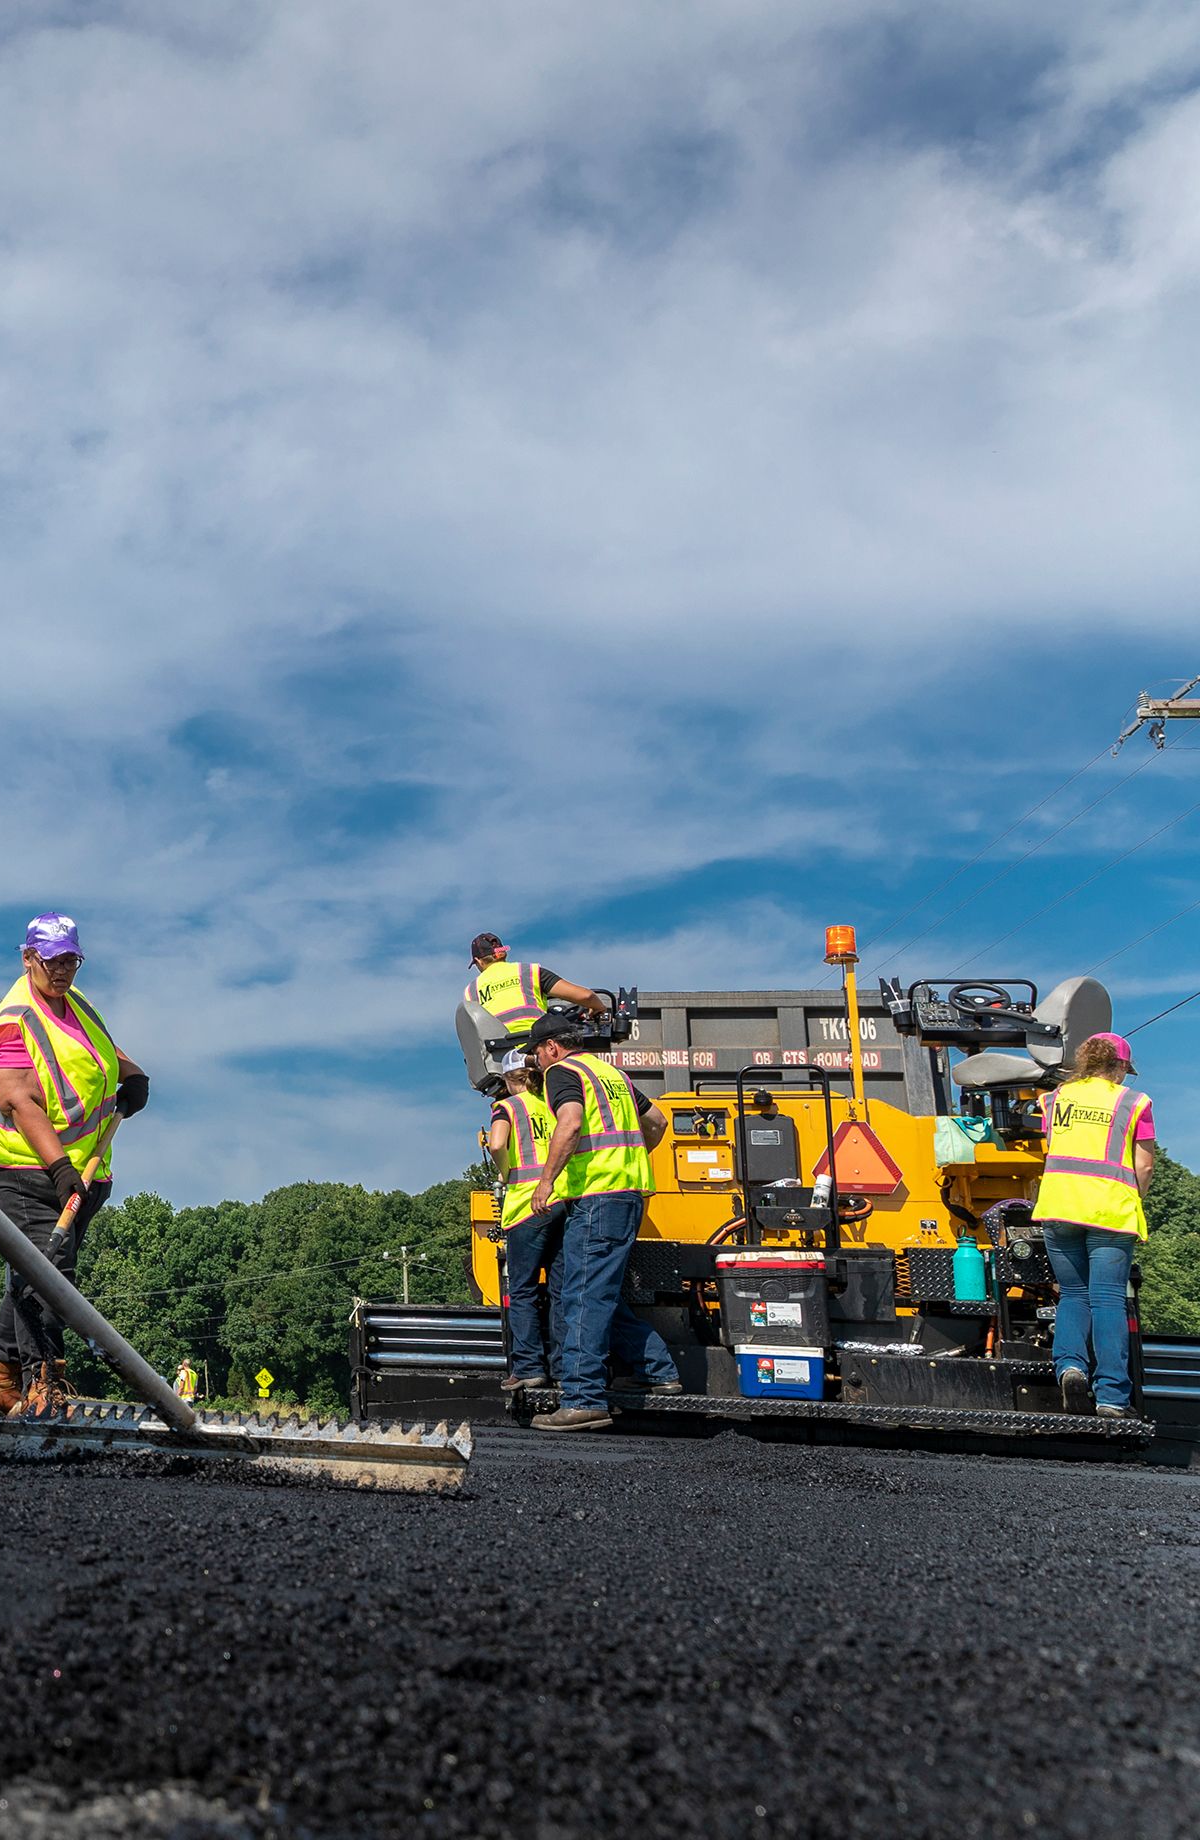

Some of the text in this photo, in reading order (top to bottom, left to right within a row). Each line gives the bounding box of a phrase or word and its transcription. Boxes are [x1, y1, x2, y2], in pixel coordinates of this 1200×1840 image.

[479, 978, 521, 1006] MAYMEAD
[622, 1050, 689, 1067] RESPONSIBLE
[693, 1052, 714, 1067] FOR
[755, 1051, 807, 1065] OBCTS
[812, 1052, 842, 1067] ROM
[1053, 1102, 1113, 1128] MAYMEAD
